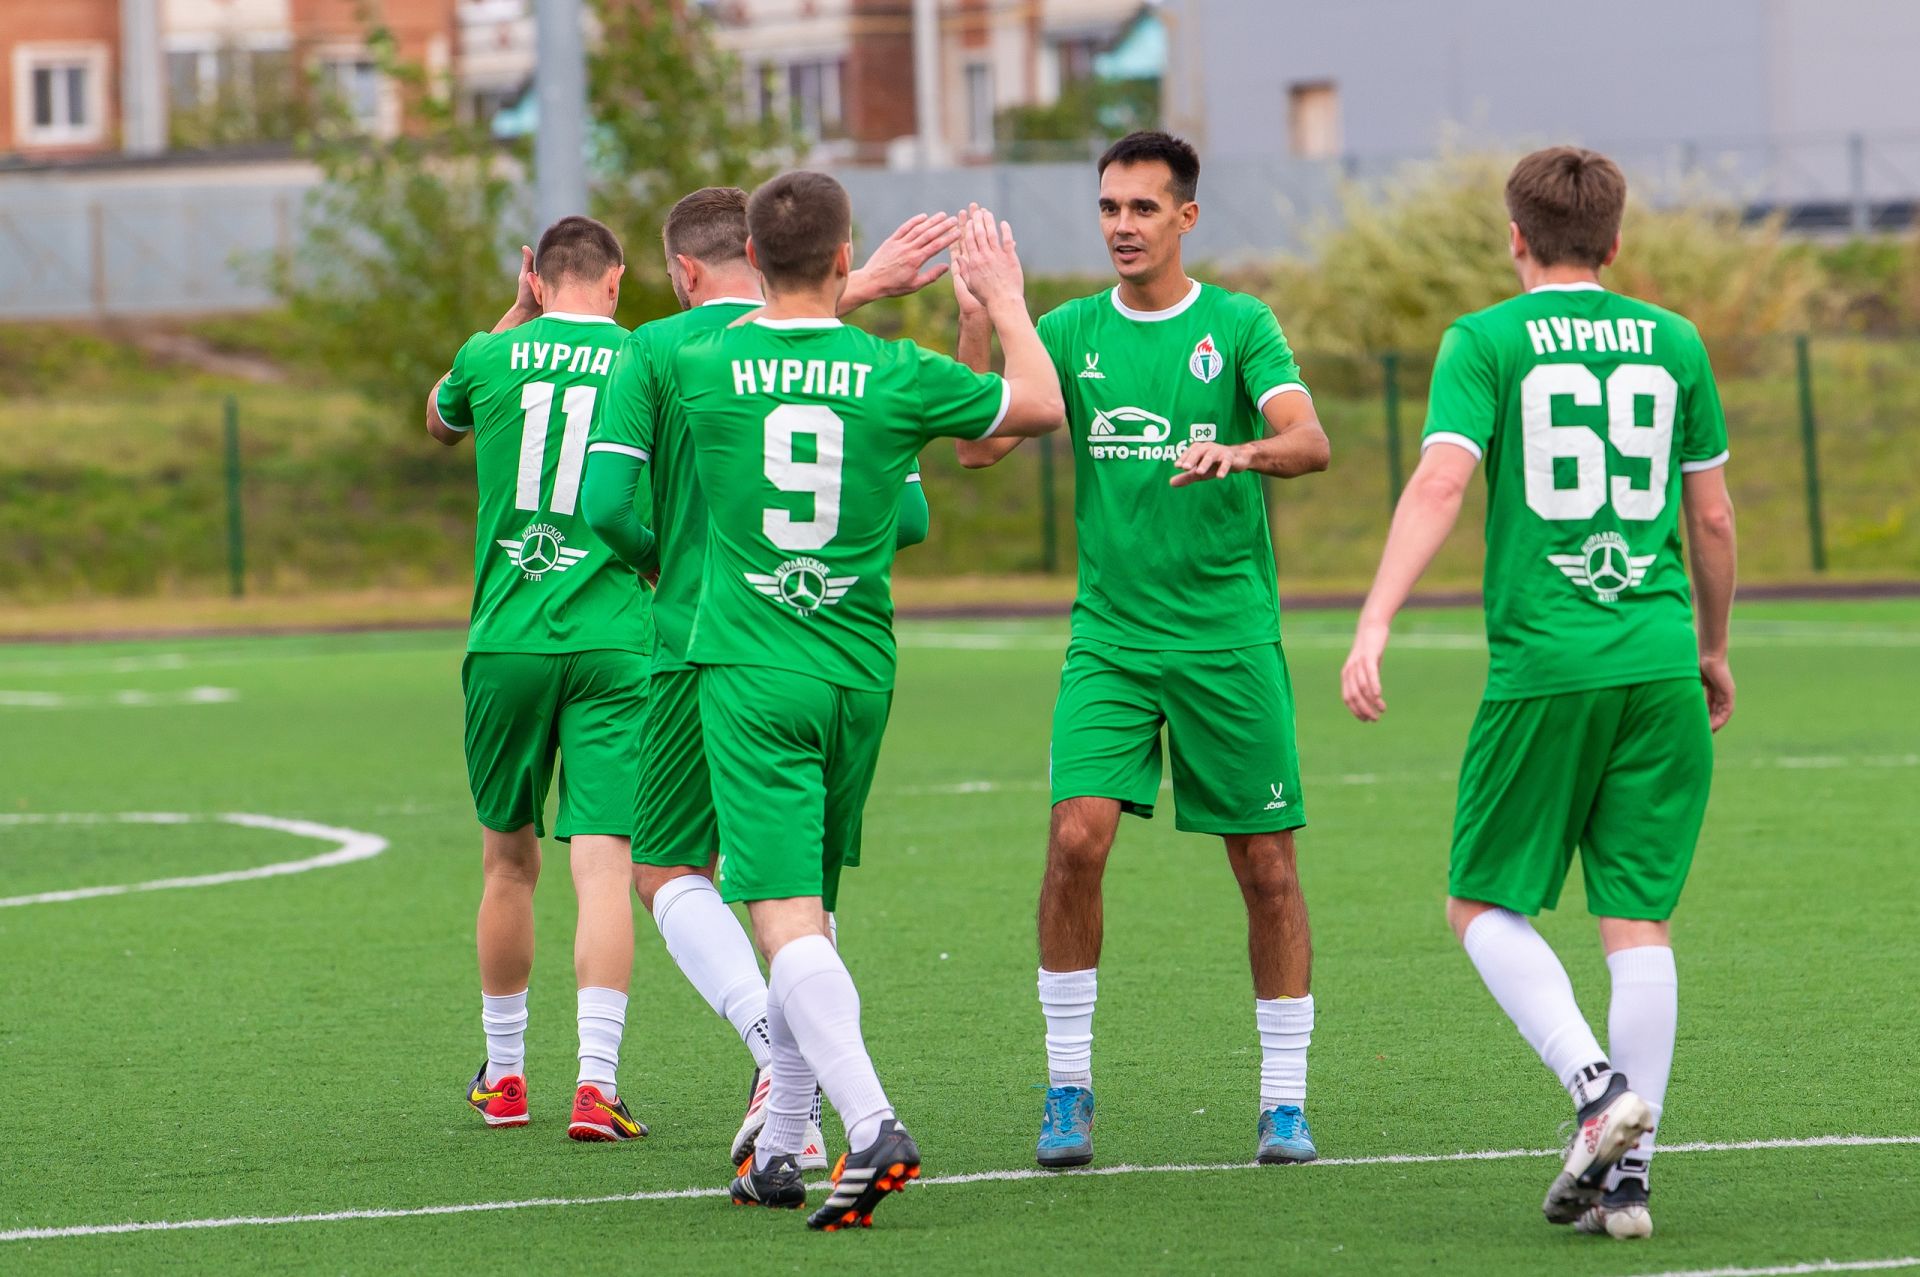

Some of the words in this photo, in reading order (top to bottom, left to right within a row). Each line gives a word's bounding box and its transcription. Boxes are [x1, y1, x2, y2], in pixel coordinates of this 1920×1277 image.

[1525, 317, 1657, 355] НУРЛАТ
[511, 341, 620, 376] НУРЛА
[731, 358, 873, 398] НУРЛАТ
[515, 380, 598, 516] 11
[1089, 439, 1188, 462] вто-подб
[1520, 363, 1679, 521] 69
[762, 403, 844, 550] 9
